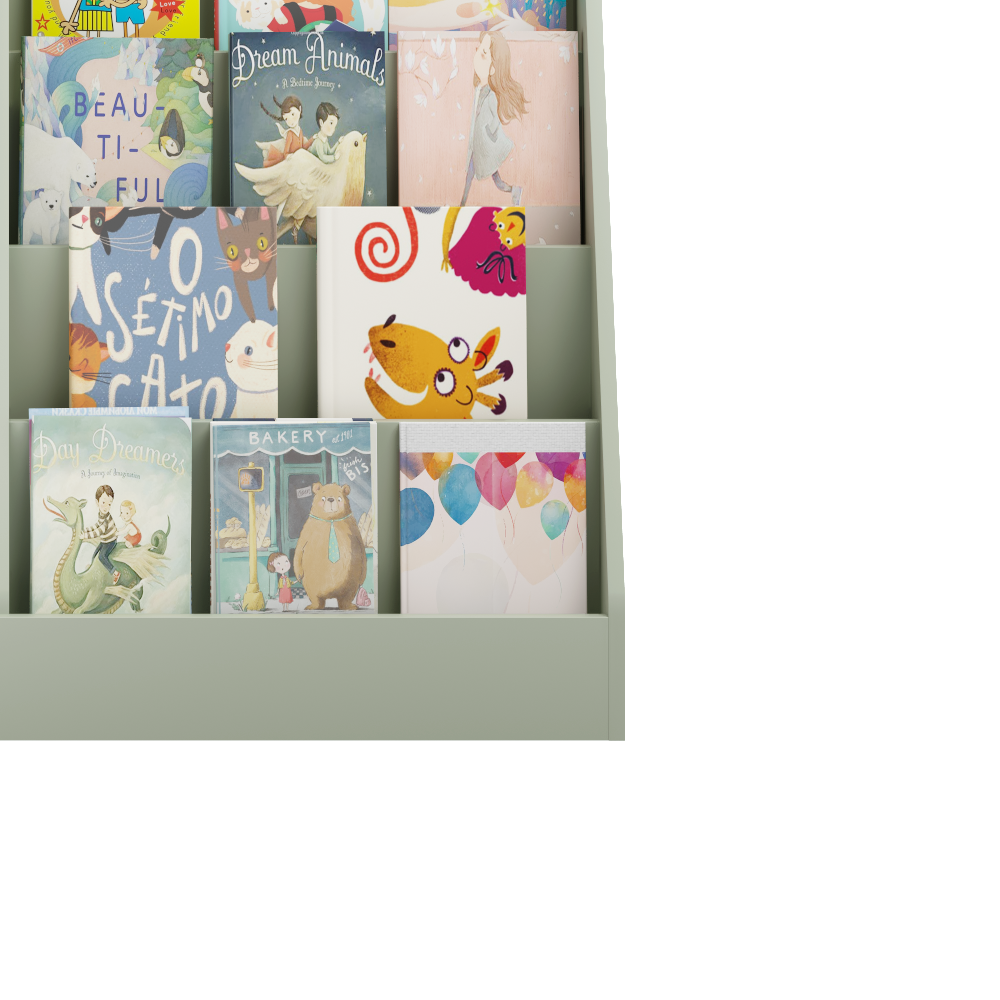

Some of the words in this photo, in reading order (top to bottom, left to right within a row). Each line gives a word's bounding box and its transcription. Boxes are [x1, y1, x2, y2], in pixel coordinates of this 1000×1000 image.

[232, 39, 300, 88] Dream
[305, 31, 385, 87] Animals
[116, 177, 164, 203] FUL
[169, 226, 203, 296] O
[33, 430, 79, 473] Day
[89, 423, 185, 475] Dreamers
[249, 430, 327, 444] BAKERY
